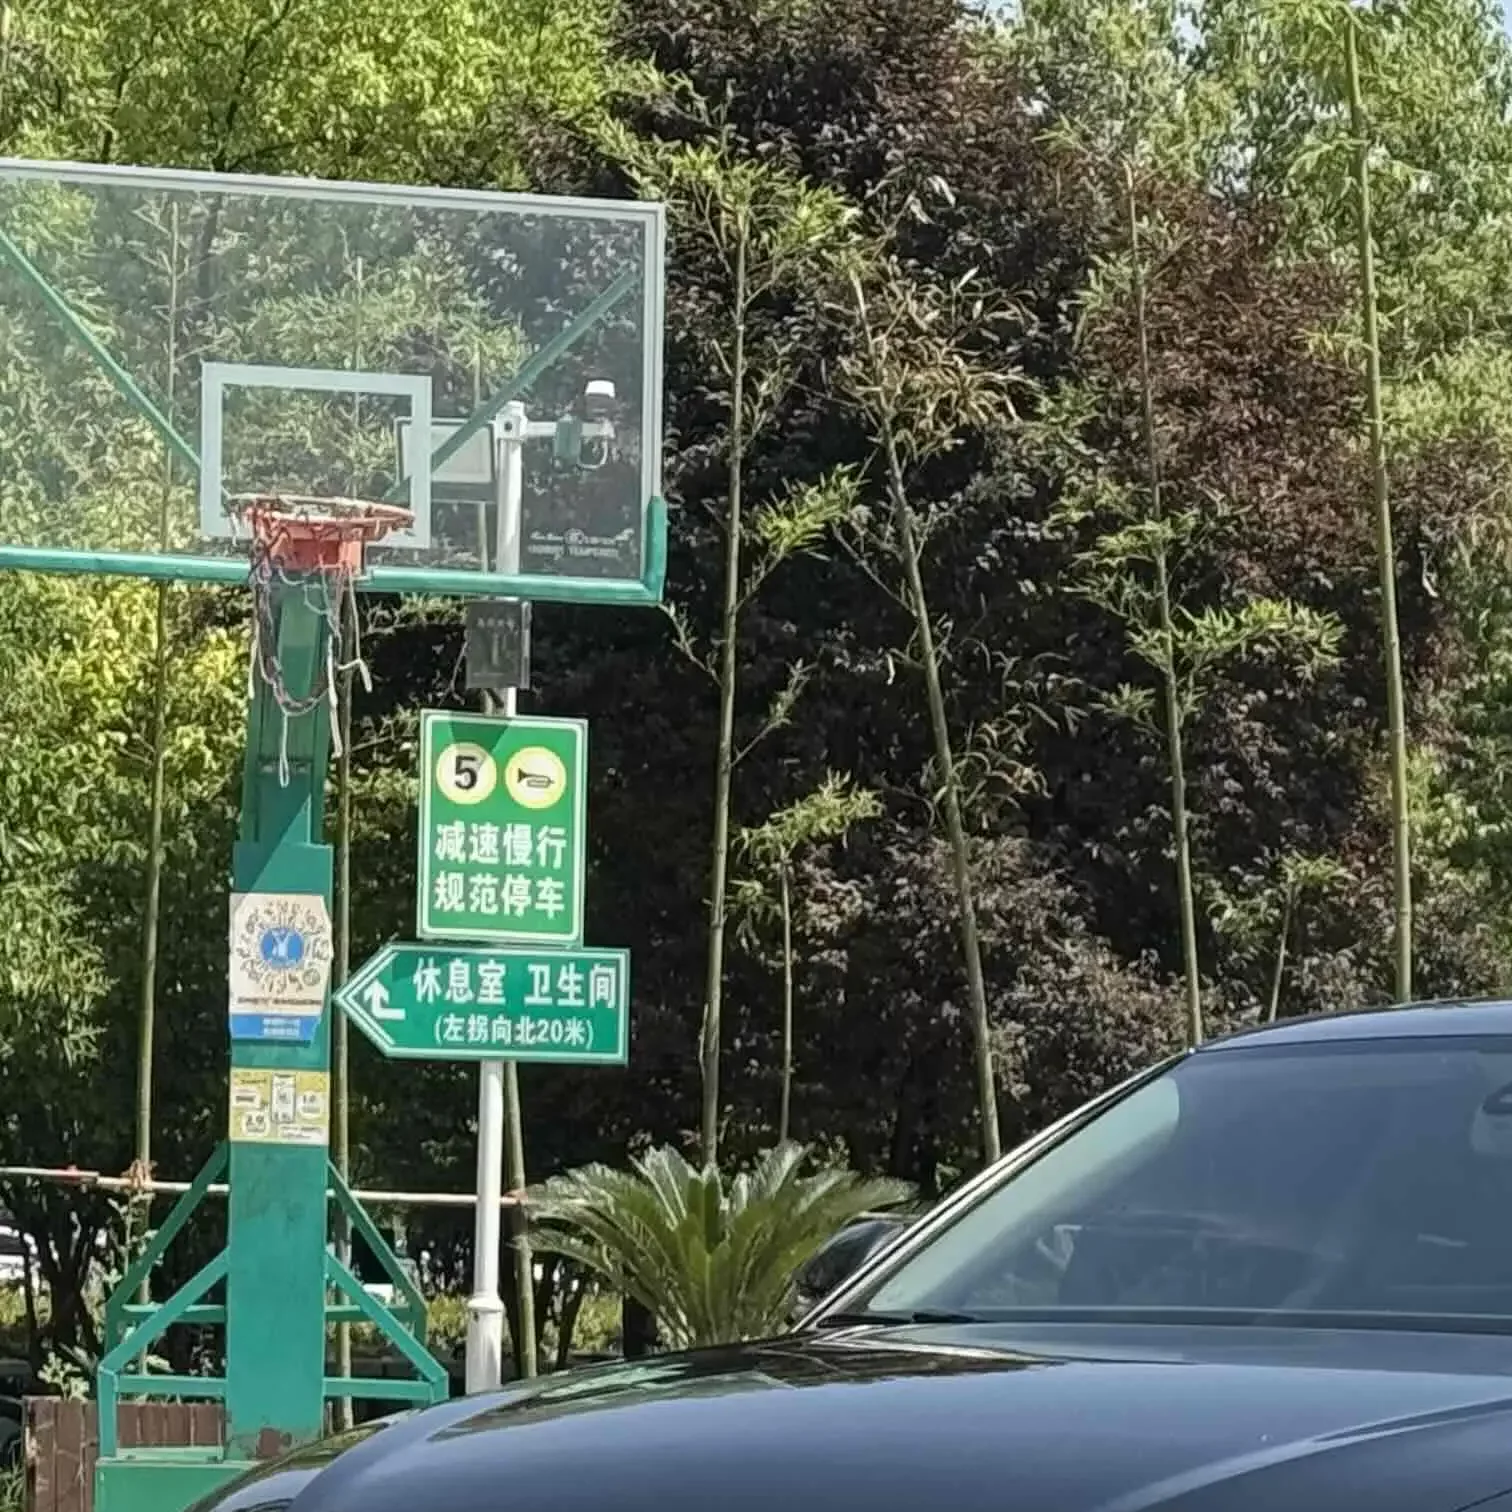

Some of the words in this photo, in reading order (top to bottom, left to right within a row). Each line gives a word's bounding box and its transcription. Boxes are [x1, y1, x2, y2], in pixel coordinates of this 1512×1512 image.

[454, 755, 479, 790] 5
[434, 820, 567, 869] 减速慢行
[433, 870, 565, 920] 规范停车
[412, 957, 506, 1005] 休息室
[523, 961, 616, 1008] 卫生间
